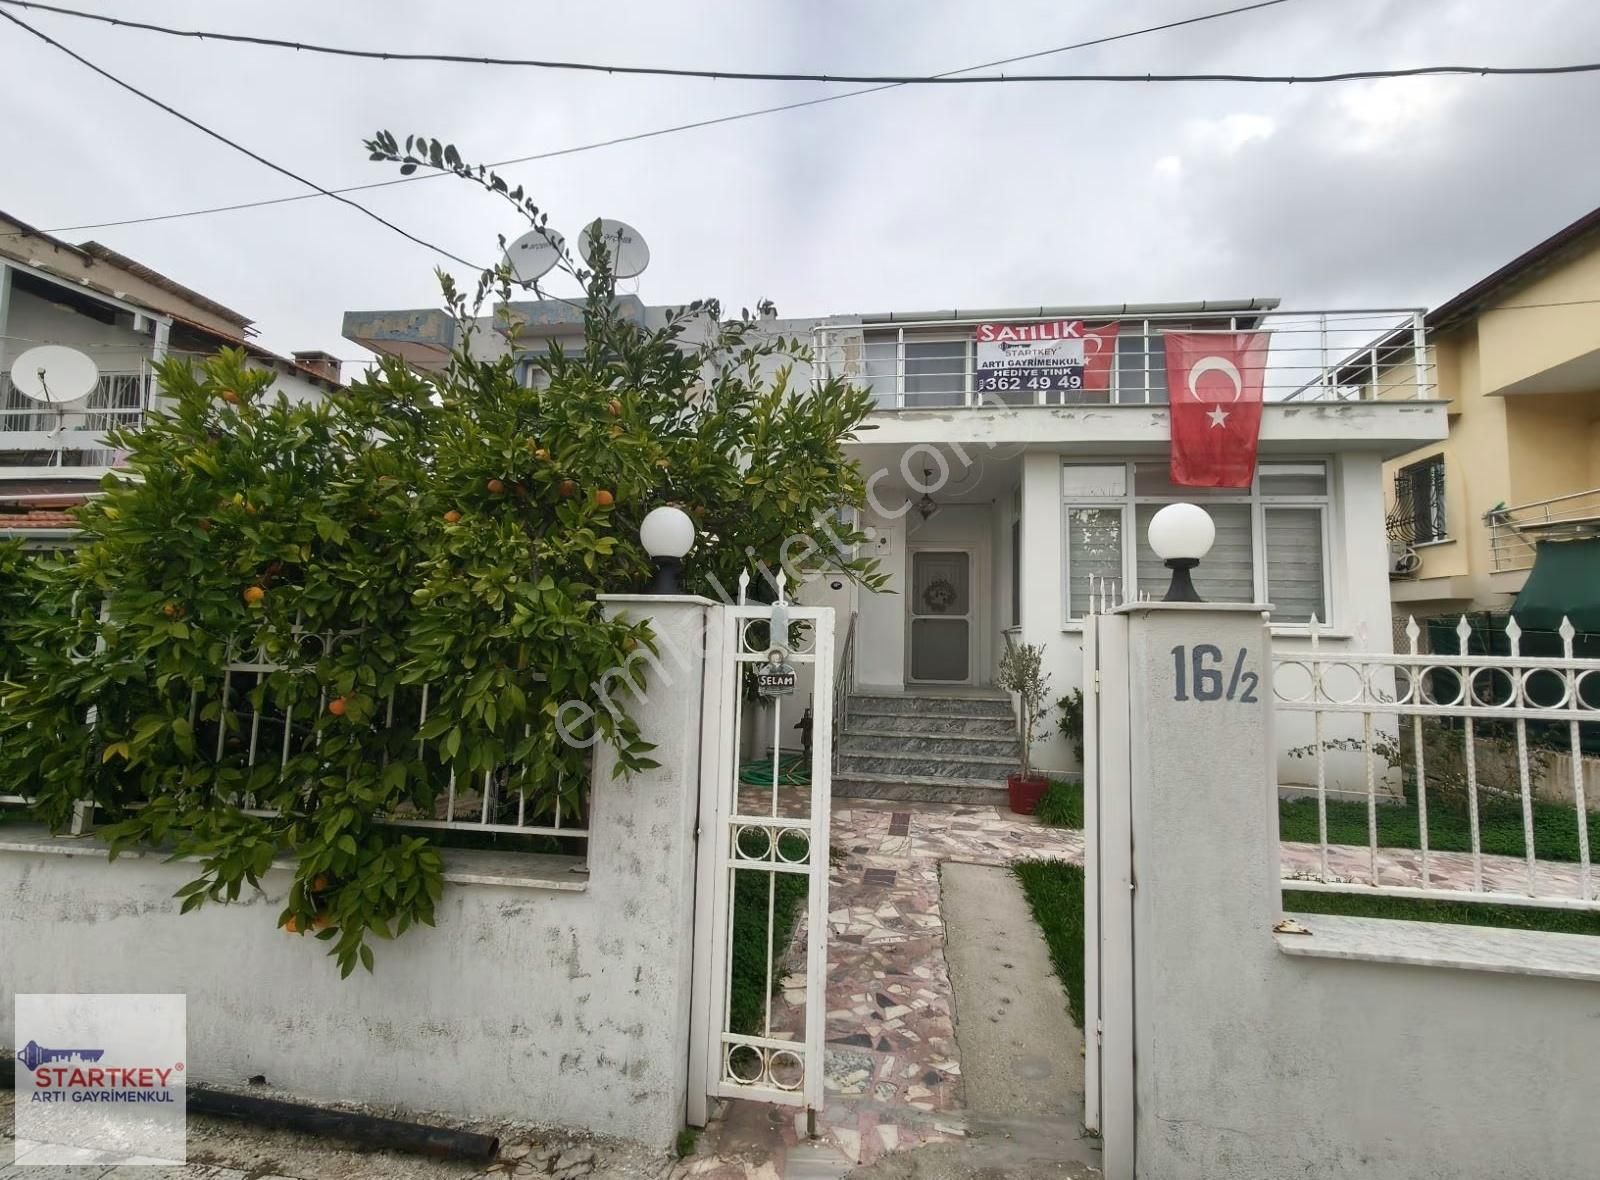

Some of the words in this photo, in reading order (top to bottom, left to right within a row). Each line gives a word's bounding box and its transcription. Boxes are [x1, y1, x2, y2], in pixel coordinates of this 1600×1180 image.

[980, 320, 1081, 341] SATILIK
[982, 361, 1004, 369] ARTI
[1008, 357, 1080, 368] GAYRİMENKUL
[993, 368, 1039, 378] HEDİYE
[1042, 368, 1072, 376] TINK
[985, 377, 1021, 390] 362
[1027, 376, 1051, 389] 49
[1058, 375, 1082, 389] 49
[760, 675, 793, 687] SELAM
